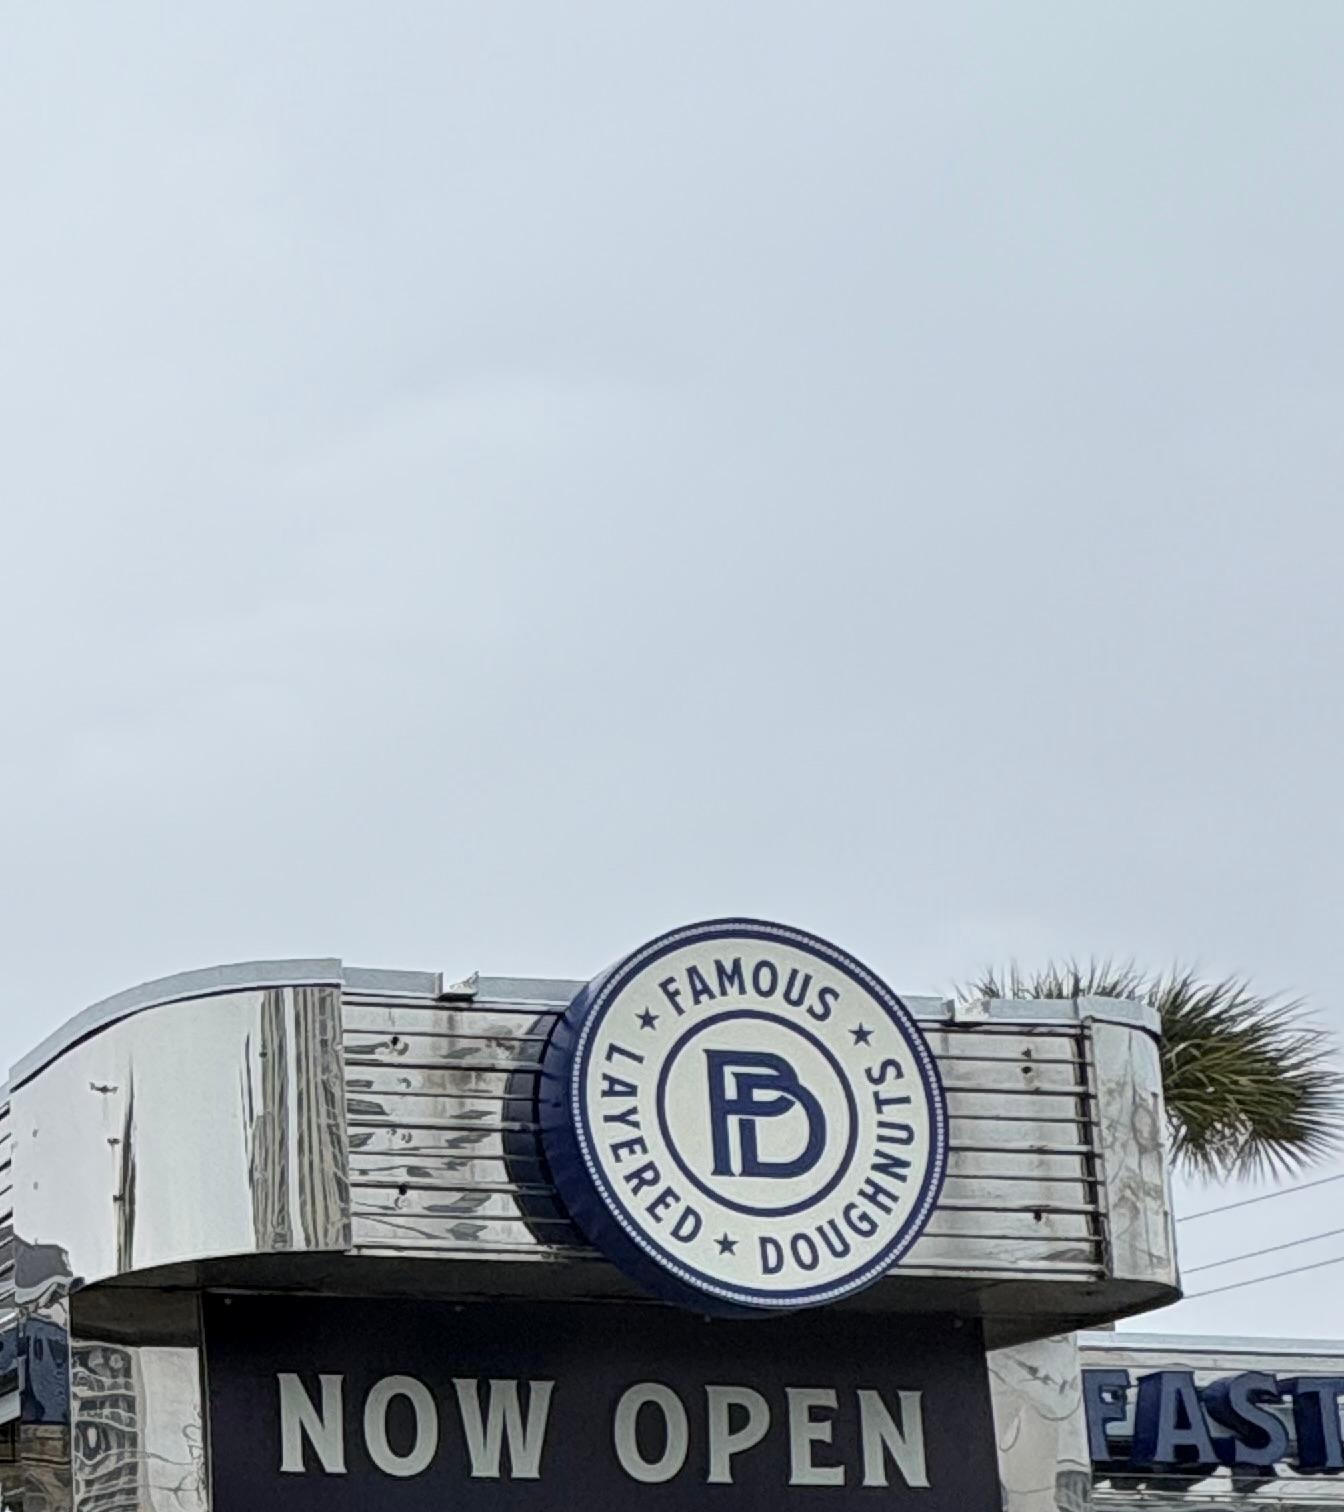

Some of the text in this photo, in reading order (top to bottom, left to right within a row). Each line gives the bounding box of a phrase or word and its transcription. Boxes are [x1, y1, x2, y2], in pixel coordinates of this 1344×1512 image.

[658, 957, 840, 1022] FAMOUS
[601, 1042, 703, 1244] LAYERED
[759, 1057, 914, 1276] DOUGHNUTS
[277, 1373, 931, 1488] NOW OPEN
